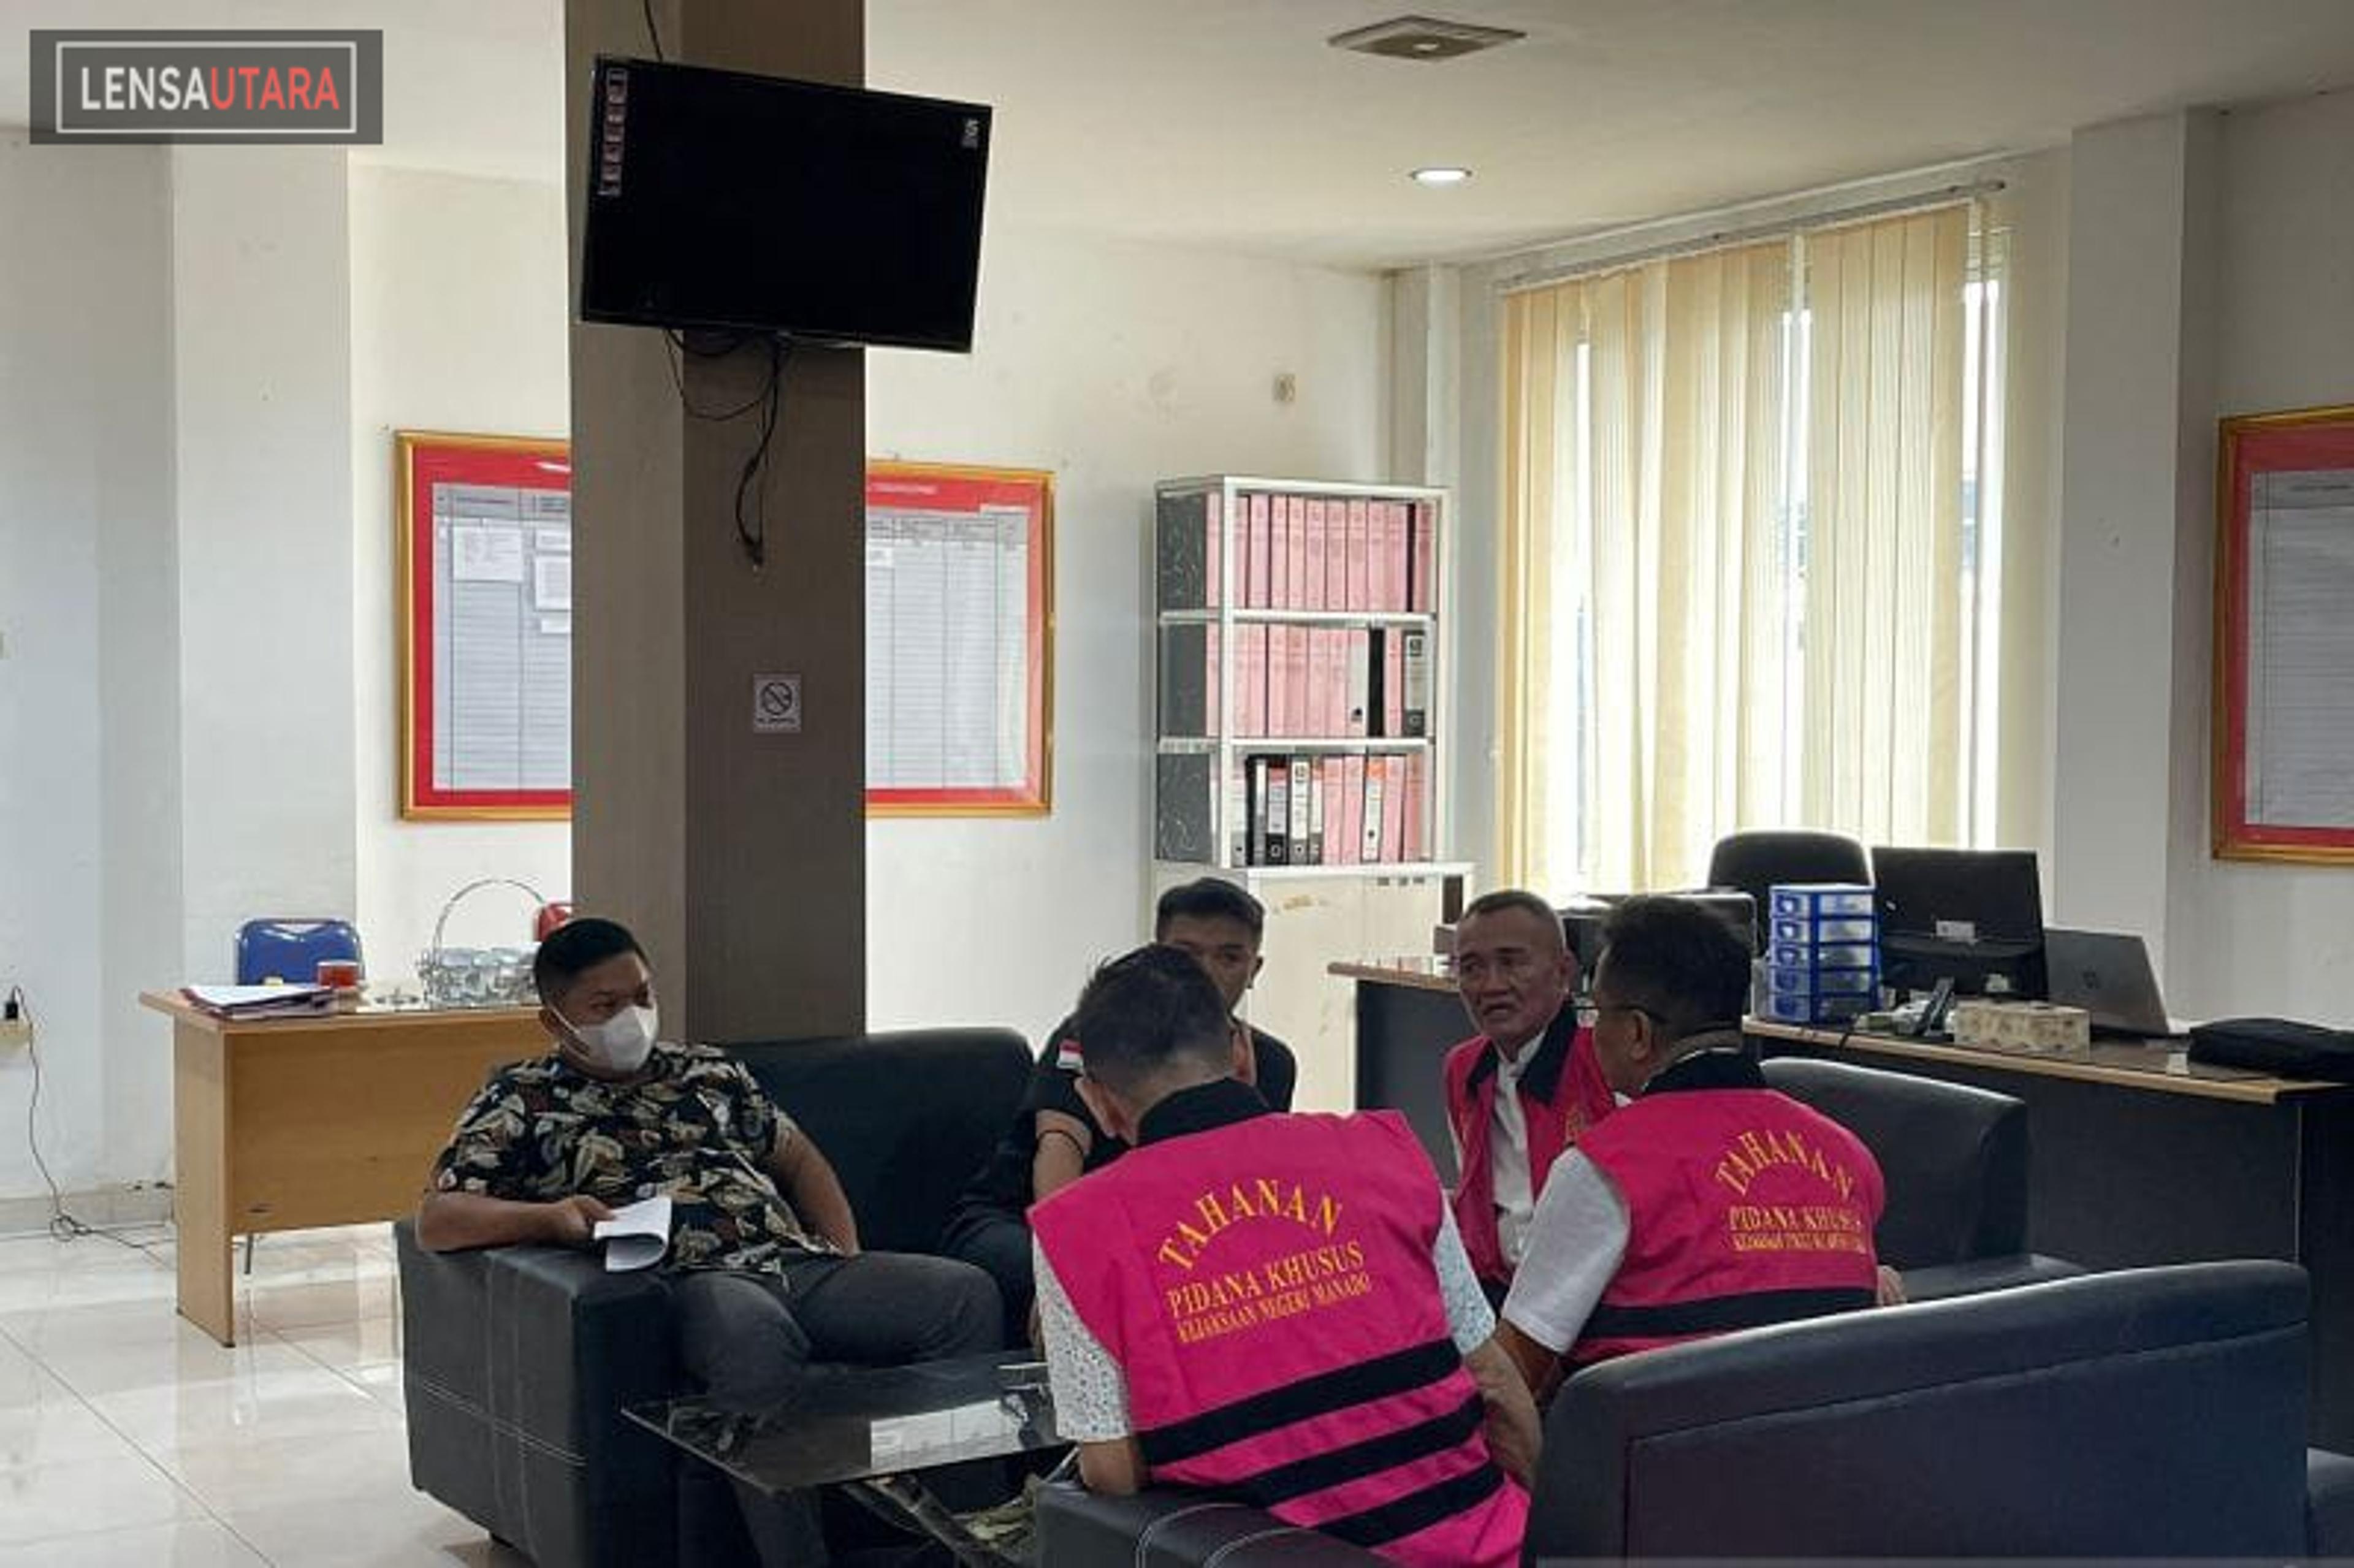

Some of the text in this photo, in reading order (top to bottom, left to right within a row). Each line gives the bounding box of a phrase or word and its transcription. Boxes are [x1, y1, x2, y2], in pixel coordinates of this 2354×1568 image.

[1715, 1130, 1854, 1203] TAHANAN
[1159, 1179, 1343, 1271] TAHANAN
[1168, 1240, 1365, 1318] PIDANA KHUSUS
